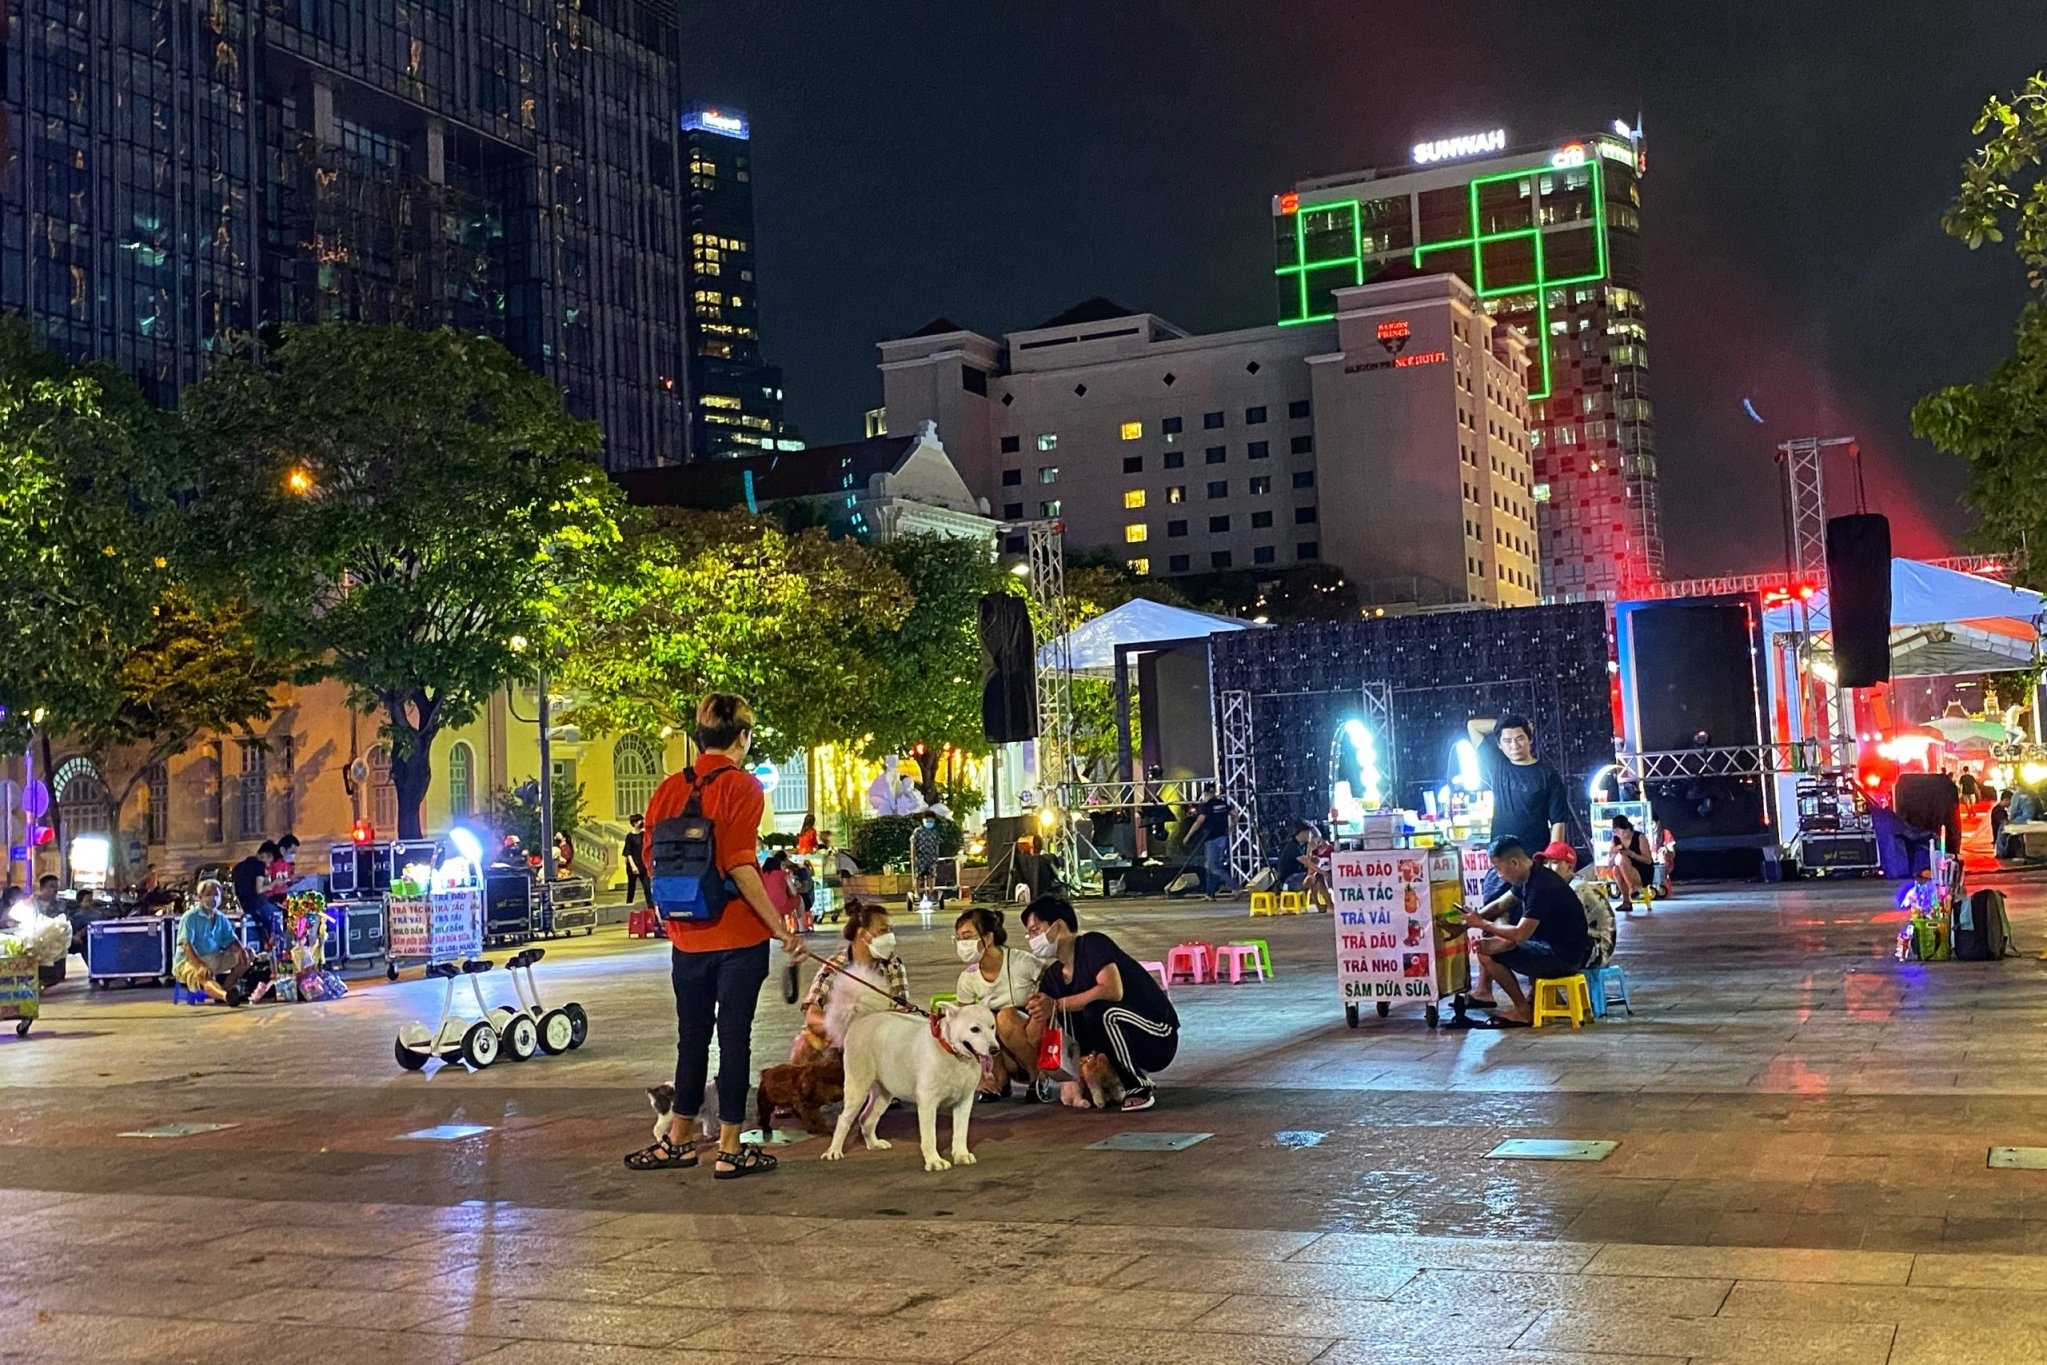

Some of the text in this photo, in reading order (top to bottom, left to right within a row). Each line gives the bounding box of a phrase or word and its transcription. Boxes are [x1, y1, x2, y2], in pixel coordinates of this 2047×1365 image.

[1413, 129, 1506, 164] SUNWAH
[1377, 329, 1411, 339] PRINCE
[1378, 321, 1409, 330] SAIGON
[1338, 860, 1393, 877] TRÀ ĐÀO
[1339, 881, 1393, 901] TRÀ TẮC
[1340, 906, 1391, 925] TRÀ VẢI
[1342, 931, 1397, 949] TRÀ DÂU
[1343, 956, 1398, 973] TRÀ NHO
[1345, 979, 1431, 997] SÂM DỨA SỮA
